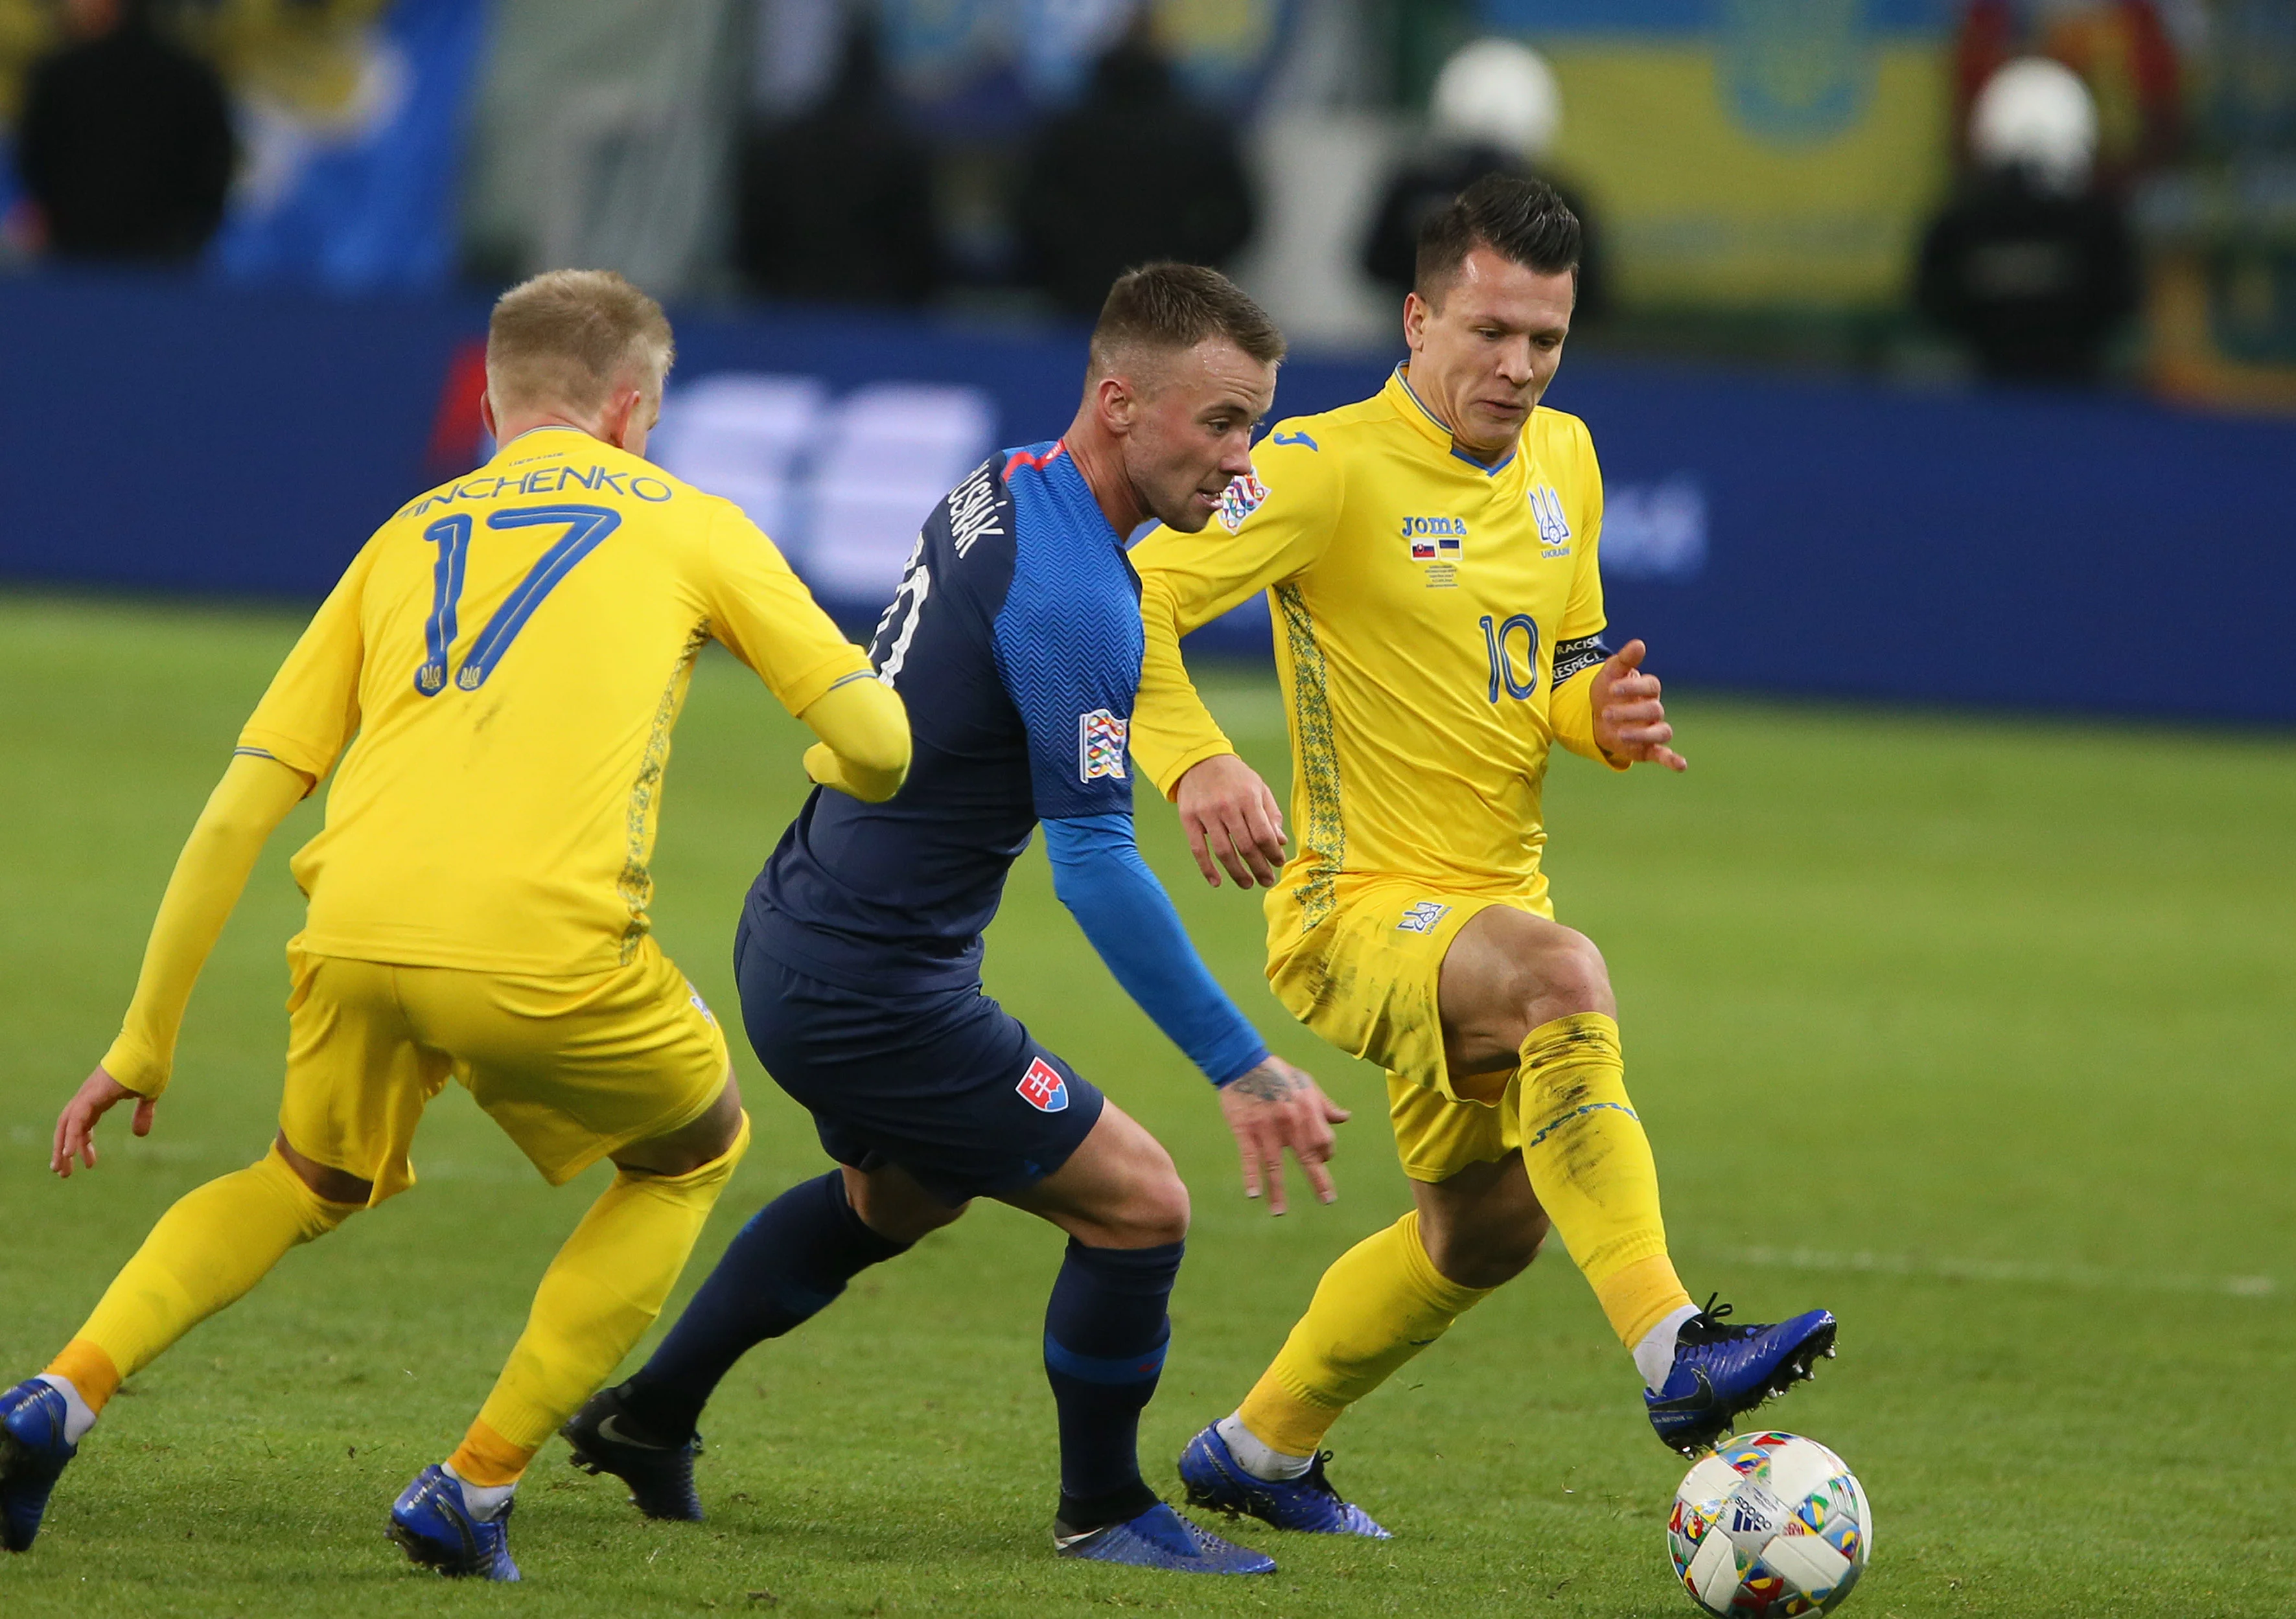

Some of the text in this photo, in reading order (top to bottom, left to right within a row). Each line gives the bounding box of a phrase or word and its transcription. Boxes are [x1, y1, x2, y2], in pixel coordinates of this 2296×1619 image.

[947, 458, 1008, 559] USNÁK
[413, 503, 622, 698] 17
[1479, 614, 1538, 704] 10
